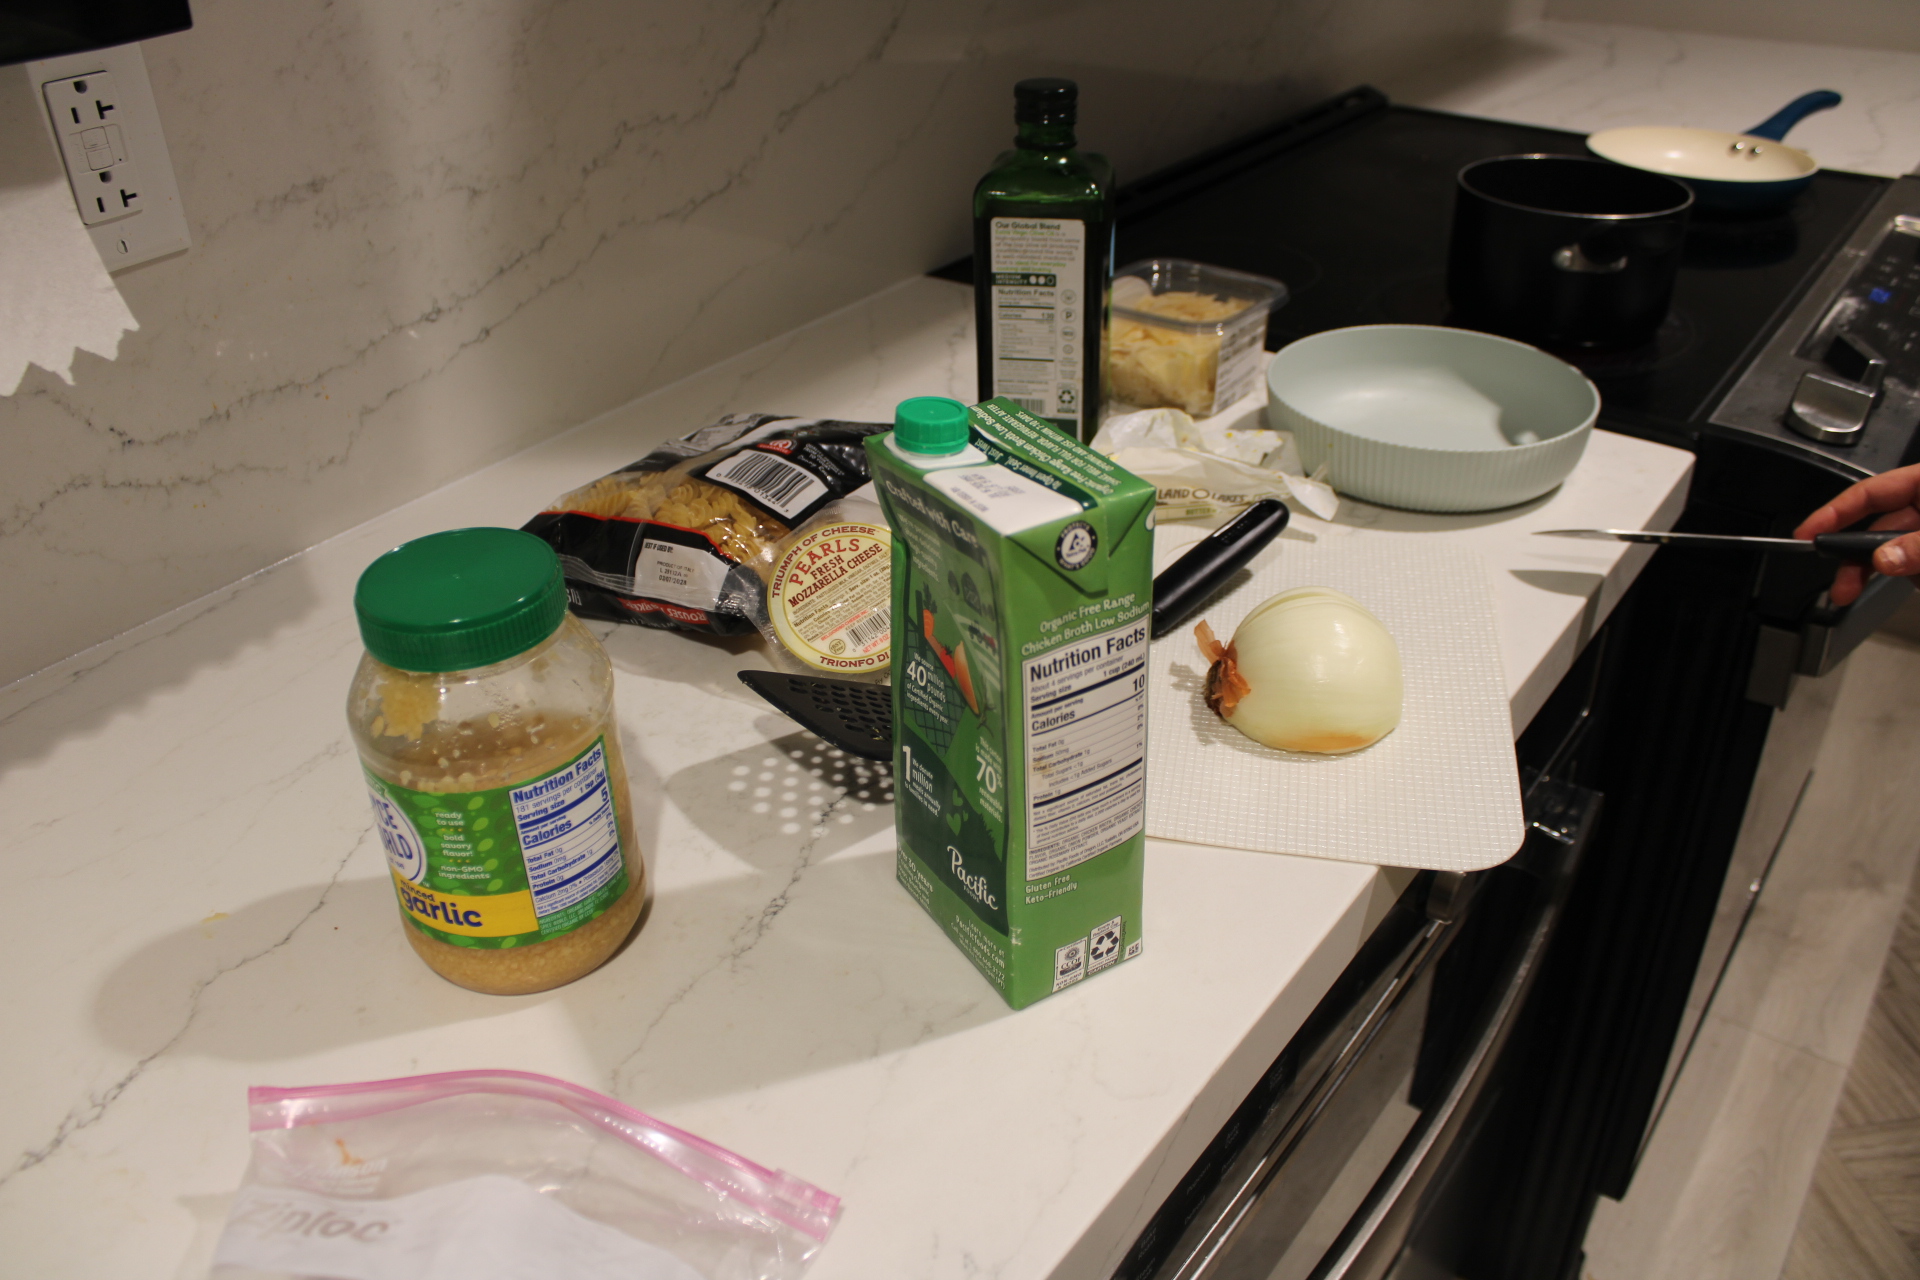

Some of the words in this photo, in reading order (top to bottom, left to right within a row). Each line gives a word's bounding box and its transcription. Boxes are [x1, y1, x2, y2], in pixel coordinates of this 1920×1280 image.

[970, 406, 996, 425] Sodium
[992, 423, 1008, 435] Low
[1004, 431, 1026, 446] Broth
[1023, 443, 1051, 461] Chicken
[1157, 488, 1190, 500] LAND
[1212, 492, 1248, 503] LAKES
[886, 480, 927, 515] Crafted
[925, 507, 952, 533] with
[951, 520, 978, 548] Care
[656, 544, 667, 552] USED
[772, 545, 802, 598] TRIUMPH
[802, 533, 818, 547] OF
[821, 526, 876, 536] CHEESE
[789, 538, 860, 586] PEARLS
[809, 554, 845, 581] FRESH
[788, 566, 848, 607] MOZZARELLA
[847, 543, 883, 569] CHEESE
[668, 607, 707, 622] ROUSES
[794, 612, 816, 627] Nutrition
[815, 604, 829, 614] Facts
[1040, 611, 1078, 633] Organic
[1079, 604, 1101, 619] Free
[1103, 593, 1136, 610] Range
[1022, 634, 1062, 656] Chicken
[1064, 622, 1093, 640] Broth
[1095, 615, 1116, 630] Low
[1117, 601, 1150, 622] Sodium
[820, 655, 875, 667] TRIONFO
[876, 652, 889, 662] DI
[862, 645, 871, 653] NET
[1030, 646, 1101, 682] Nutrition
[1106, 627, 1146, 655] Facts
[907, 661, 927, 687] 40
[927, 671, 945, 690] million
[920, 658, 934, 672] source
[1031, 682, 1050, 693] About
[1057, 669, 1083, 685] servings
[1084, 666, 1095, 676] per
[1096, 655, 1124, 671] container
[1031, 689, 1057, 703] Serving
[1058, 684, 1072, 694] size
[1108, 665, 1121, 676] cup
[1121, 658, 1135, 672] (240
[907, 690, 929, 711] ingredients
[928, 707, 940, 720] every
[911, 685, 929, 701] Certified
[929, 696, 944, 712] Organic
[927, 683, 946, 703] pounds
[1031, 710, 1076, 731] Calories
[1132, 674, 1146, 691] 10
[1031, 708, 1053, 719] Amount
[1054, 706, 1065, 714] per
[1065, 697, 1084, 709] serving
[1032, 744, 1047, 752] Total
[1048, 741, 1057, 749] Fat
[1033, 753, 1054, 763] Sodium
[903, 745, 911, 782] 1
[912, 757, 919, 768] We
[919, 764, 933, 780] donate
[1033, 765, 1047, 773] Total
[1048, 751, 1083, 768] Carbohydrate
[513, 771, 574, 803] Nutrition
[575, 748, 602, 776] Facts
[912, 769, 933, 793] million
[516, 804, 530, 813] 181
[532, 793, 562, 808] servings
[562, 786, 573, 796] per
[574, 767, 597, 788] container
[517, 807, 549, 821] Serving
[550, 799, 566, 810] size
[585, 781, 595, 790] tsp
[913, 781, 924, 795] meals
[924, 791, 941, 812] annually
[1033, 792, 1054, 801] Protein
[435, 812, 462, 820] ready
[521, 826, 540, 835] Amount
[549, 815, 567, 825] serving
[522, 820, 572, 846] Calories
[601, 786, 609, 802] 5
[526, 855, 543, 864] Total
[555, 847, 563, 855] 0g
[528, 861, 553, 872] Sodium
[553, 855, 567, 863] 0mg
[530, 872, 546, 881] Total
[547, 854, 586, 876] Carbohydrate
[438, 871, 491, 879] ingredients
[532, 878, 556, 890] Protein
[556, 874, 564, 882] 0g
[908, 858, 916, 872] 30
[916, 870, 933, 893] years
[947, 845, 999, 910] Pacific
[1025, 881, 1052, 894] Gluten
[1054, 873, 1071, 886] Free
[400, 880, 435, 902] minced
[535, 891, 557, 903] Calcium
[557, 887, 569, 897] 2mg
[1025, 881, 1078, 905] Keto-Friendly
[400, 887, 483, 928] garlic
[969, 920, 982, 938] Learn
[983, 936, 997, 951] more
